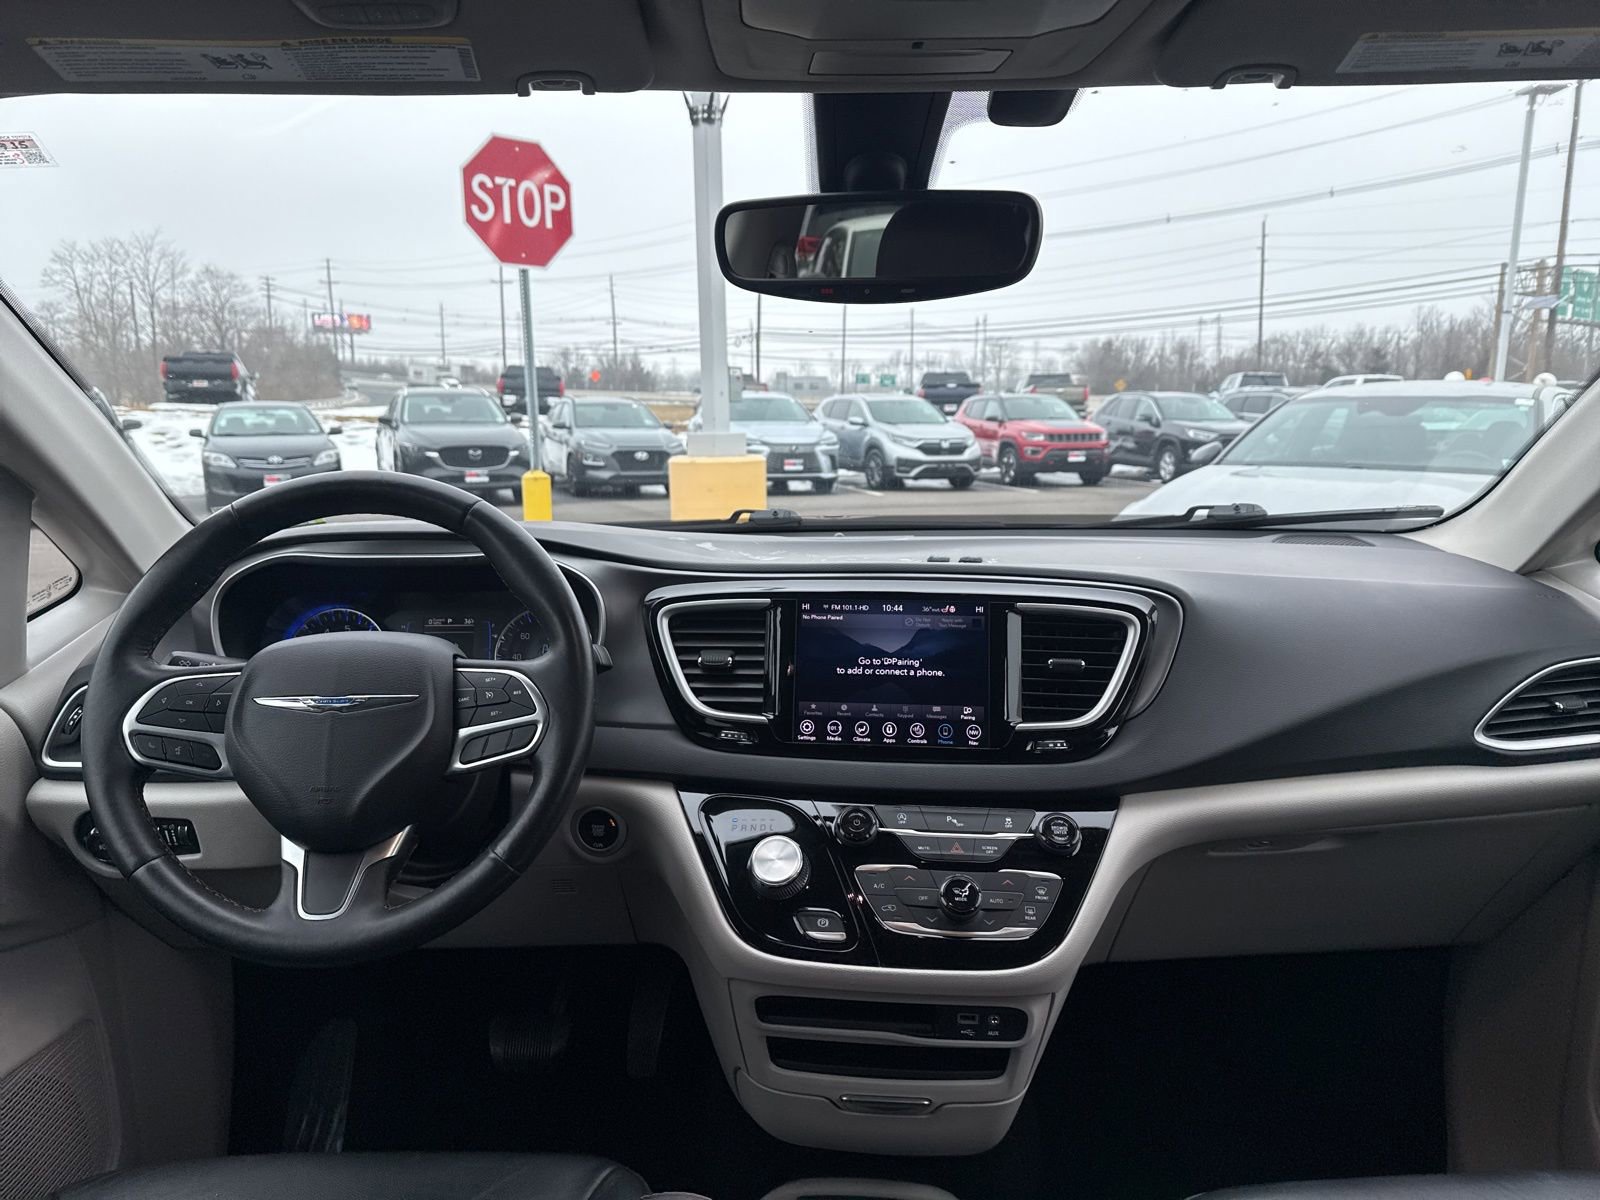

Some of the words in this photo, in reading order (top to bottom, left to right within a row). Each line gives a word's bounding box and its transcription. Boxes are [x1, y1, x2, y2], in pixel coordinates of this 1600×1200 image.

[470, 173, 566, 229] STOP
[882, 604, 903, 612] 10:44
[858, 656, 871, 665] Go
[847, 666, 863, 675] add
[875, 668, 908, 676] connect
[916, 668, 945, 678] phone.
